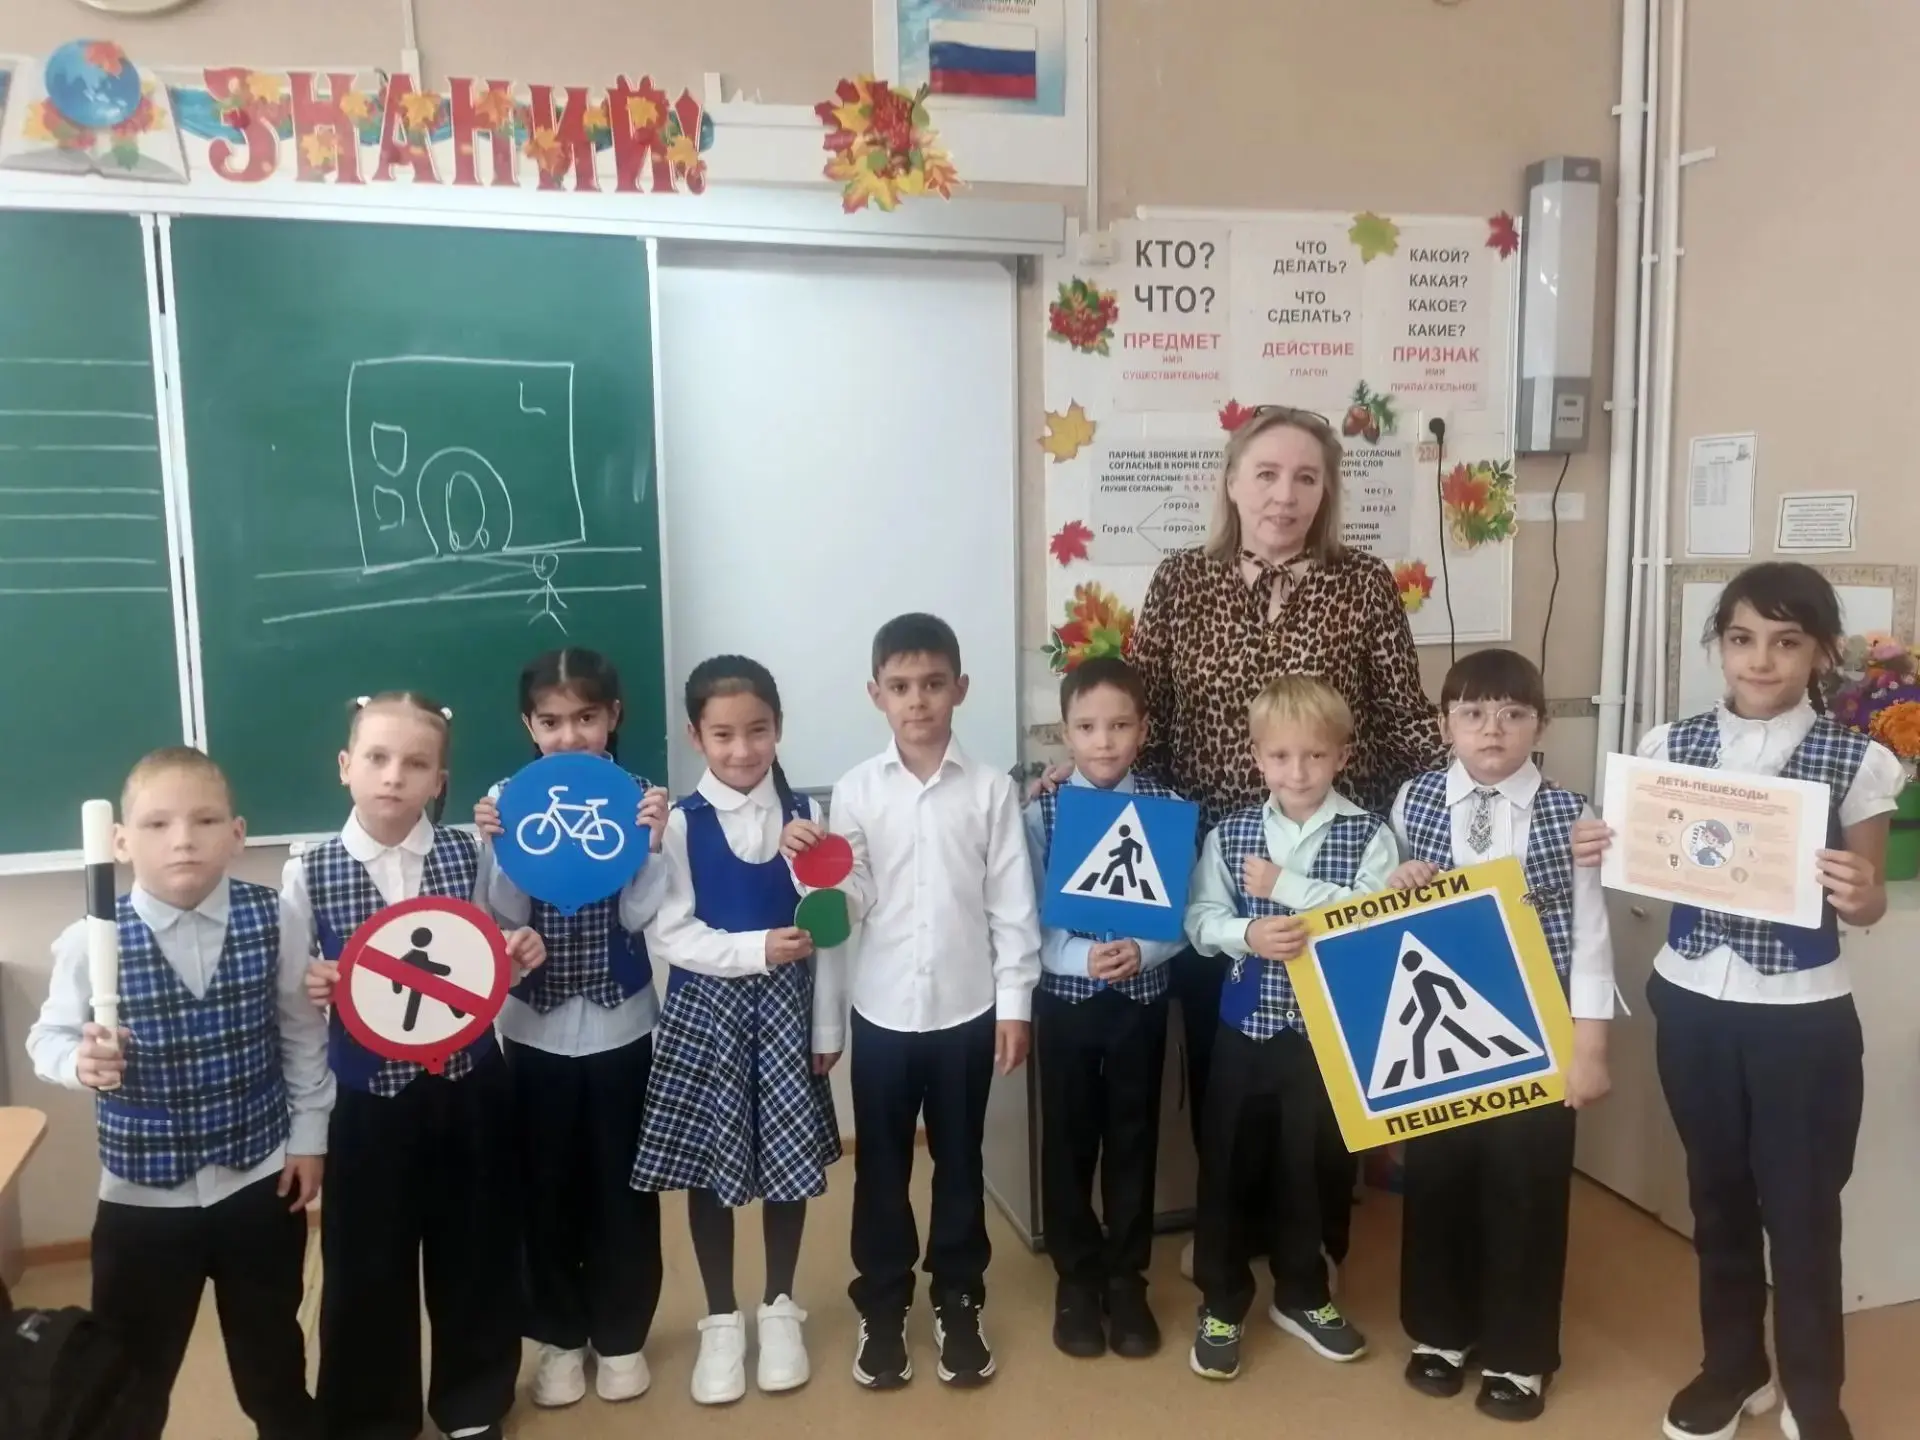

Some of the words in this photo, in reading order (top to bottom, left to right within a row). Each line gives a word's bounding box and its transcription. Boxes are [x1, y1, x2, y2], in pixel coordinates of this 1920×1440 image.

[202, 67, 707, 195] ЗНАНИЙ!
[1135, 239, 1215, 269] КТО?
[1296, 241, 1327, 254] ЧТО
[1409, 247, 1470, 263] КАКОЙ?
[1273, 259, 1347, 275] ДЕЛАТЬ?
[1409, 273, 1468, 288] КАКАЯ?
[1134, 284, 1216, 313] ЧТО?
[1295, 291, 1326, 304] ЧТО
[1408, 299, 1467, 313] КАКОЕ?
[1267, 308, 1351, 324] СДЕЛАТЬ?
[1408, 323, 1466, 337] КАКИЕ?
[1123, 332, 1221, 351] ПРЕДМЕТ
[1262, 340, 1354, 357] ДЕЙСТВИЕ
[1162, 355, 1183, 365] ИМЯ
[1392, 346, 1480, 363] ПРИЗНАК
[1122, 370, 1220, 381] СУЩЕСТВИТЕЛЬНОЕ
[1289, 367, 1328, 378] ГЛАГОЛ
[1390, 382, 1478, 393] ПРИЛАГАТЕЛЬНОЕ
[1108, 450, 1146, 460] ПАРНЫЕ
[1148, 450, 1189, 460] ЗВОНКИЕ
[1190, 450, 1197, 460] И
[1198, 450, 1224, 460] ГЛУХ
[1109, 461, 1161, 470] СОГЛАСНЫЕ
[1171, 461, 1200, 470] КОРНЕ
[1201, 461, 1224, 470] СЛО
[1163, 501, 1200, 511] города
[1102, 524, 1133, 535] Город
[1163, 523, 1206, 534] городок
[1656, 775, 1769, 801] ДЕТИ-ПЕШЕХОДЫ
[1324, 873, 1471, 930] ПРОПУСТИ
[1385, 1081, 1549, 1137] ПЕШЕХОДА
